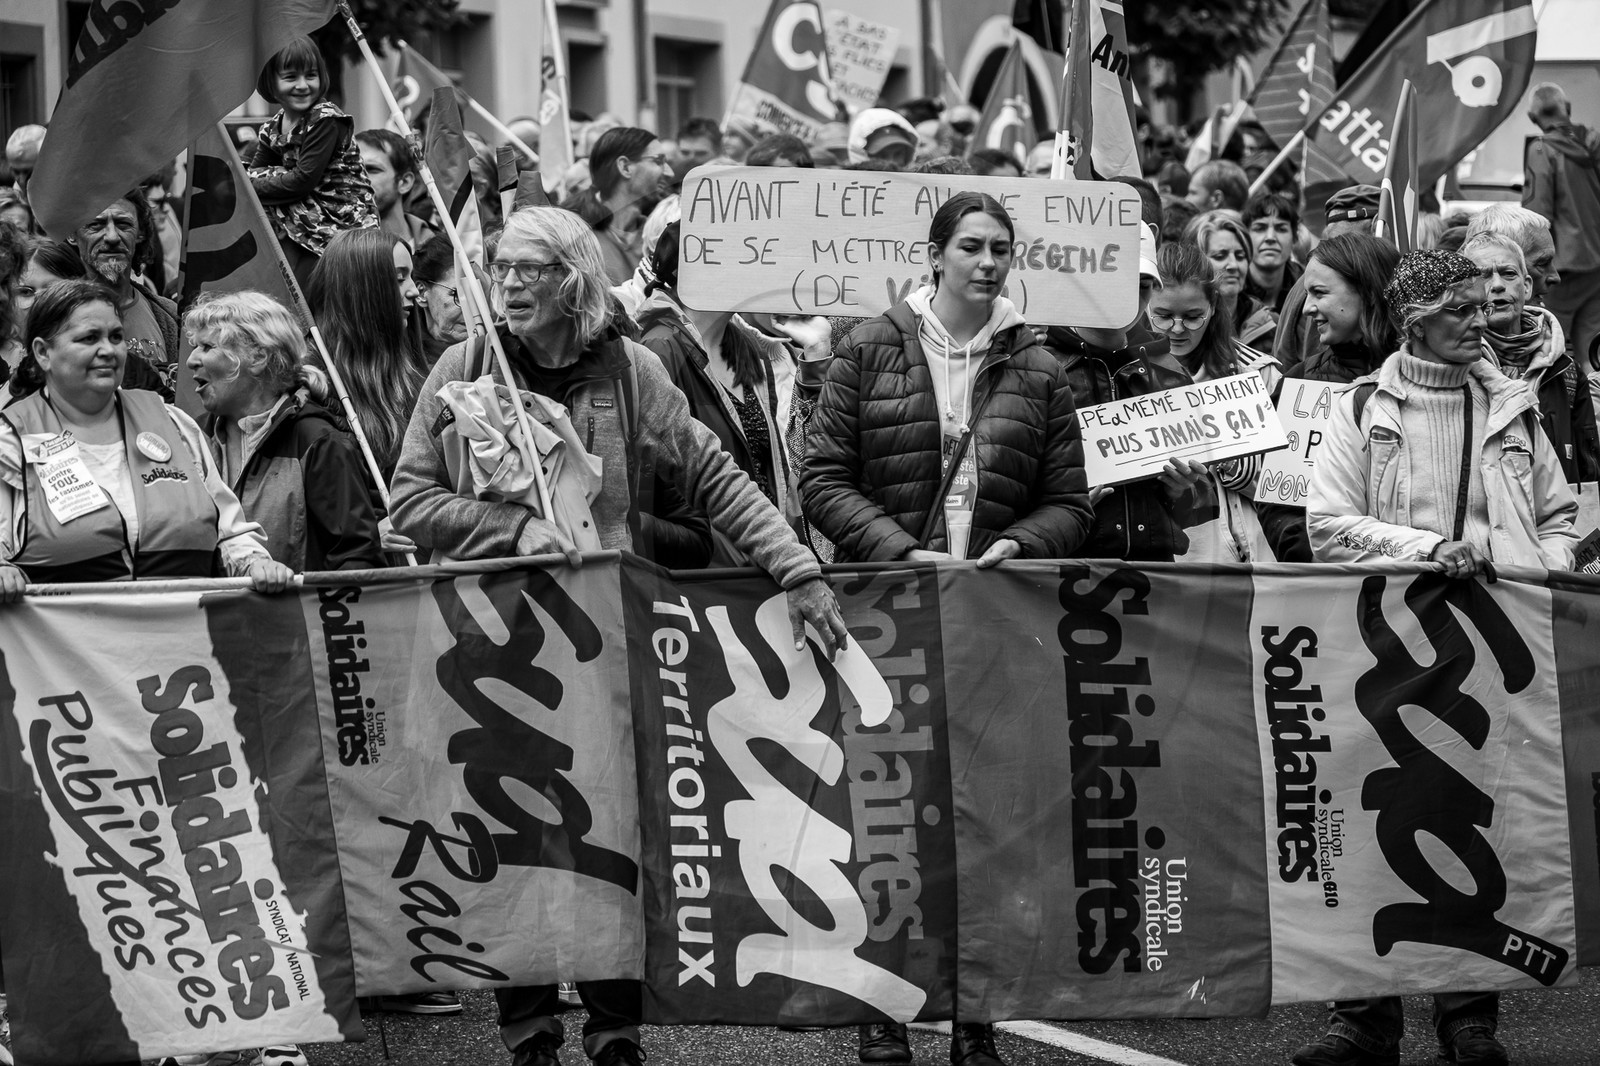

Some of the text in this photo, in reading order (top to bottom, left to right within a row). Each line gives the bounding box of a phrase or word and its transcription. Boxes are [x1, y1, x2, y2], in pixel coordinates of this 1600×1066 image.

[1319, 100, 1390, 173] atta
[689, 177, 799, 223] AVANT
[815, 180, 892, 218] L'ÉTÉ
[683, 234, 724, 265] DE
[739, 237, 780, 265] SE
[812, 238, 929, 265] METTRE
[1096, 433, 1143, 459] PLUS
[1225, 409, 1253, 439] ÇA
[1123, 391, 1181, 420] MÉMÉ
[48, 468, 72, 484] contre
[51, 474, 79, 492] TOUS
[316, 586, 375, 766] Solidaires
[365, 712, 380, 764] syndicale
[375, 711, 386, 746] Union
[1261, 625, 1333, 883] Solidaires
[651, 595, 722, 988] Territoriaux
[1057, 566, 1168, 975] Solidaires
[136, 665, 291, 1020] Solidaires
[1318, 808, 1339, 908] syndicale G10
[1330, 808, 1345, 857] Union
[378, 812, 510, 983] Rail
[1140, 857, 1168, 973] syndicale
[1166, 857, 1187, 935] Union
[266, 899, 310, 1000] SYNDICAT NATIONAL
[1502, 933, 1557, 976] PTT
